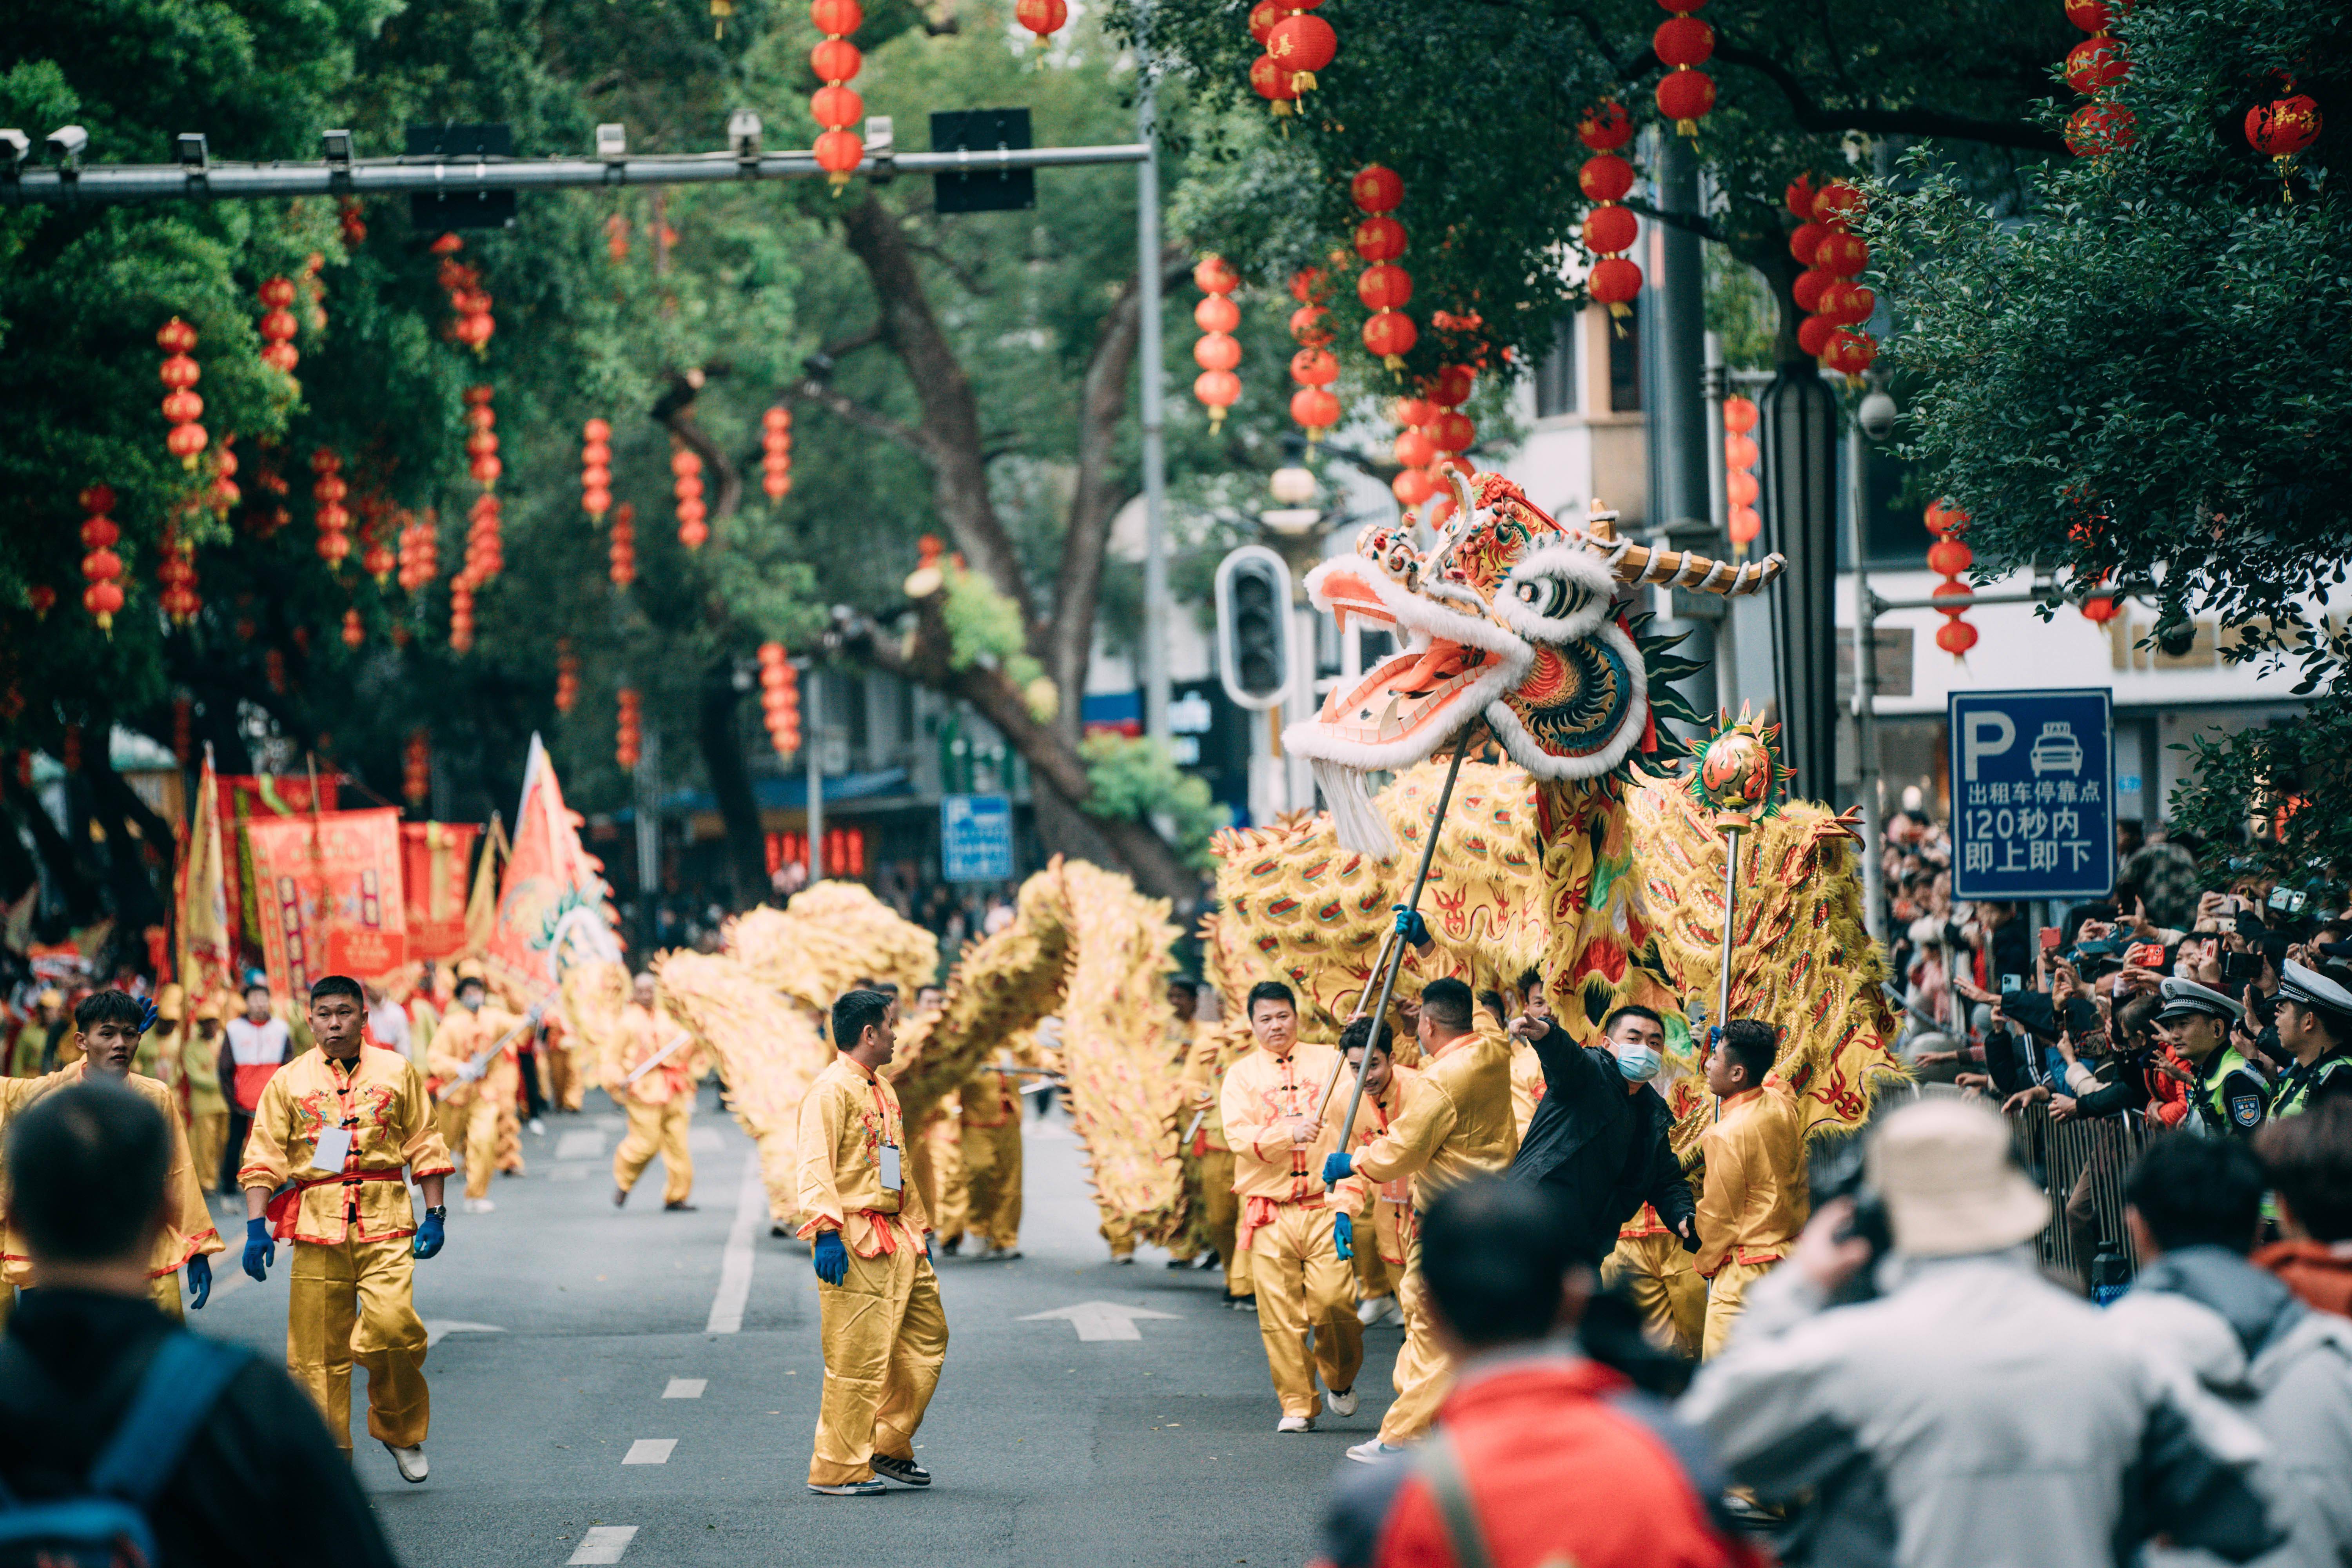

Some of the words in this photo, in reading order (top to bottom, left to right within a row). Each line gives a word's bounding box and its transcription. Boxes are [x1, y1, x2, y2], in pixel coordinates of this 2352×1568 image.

[1964, 711, 2016, 781] P
[1969, 780, 2100, 805] 出租车停靠点
[1965, 806, 2079, 840] 120秒内
[1965, 840, 2091, 874] 即上即下
